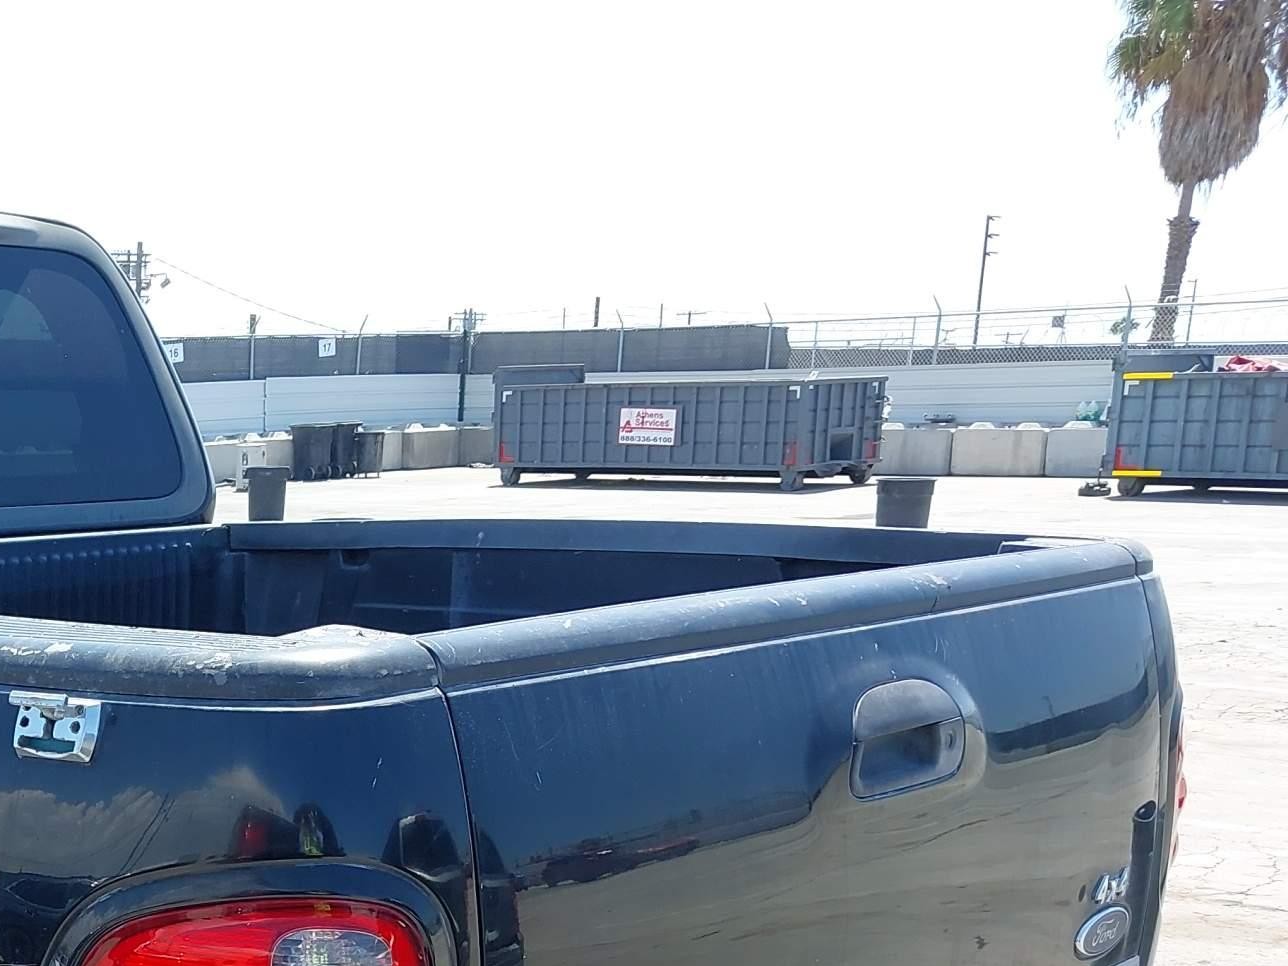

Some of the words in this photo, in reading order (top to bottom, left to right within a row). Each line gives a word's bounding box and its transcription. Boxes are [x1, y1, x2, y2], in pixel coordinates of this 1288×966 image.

[323, 342, 332, 353] 17
[169, 348, 179, 358] 16
[635, 411, 664, 420] Athens
[635, 418, 670, 428] Services
[1095, 866, 1130, 905] 4x4
[1091, 918, 1121, 948] Ford
